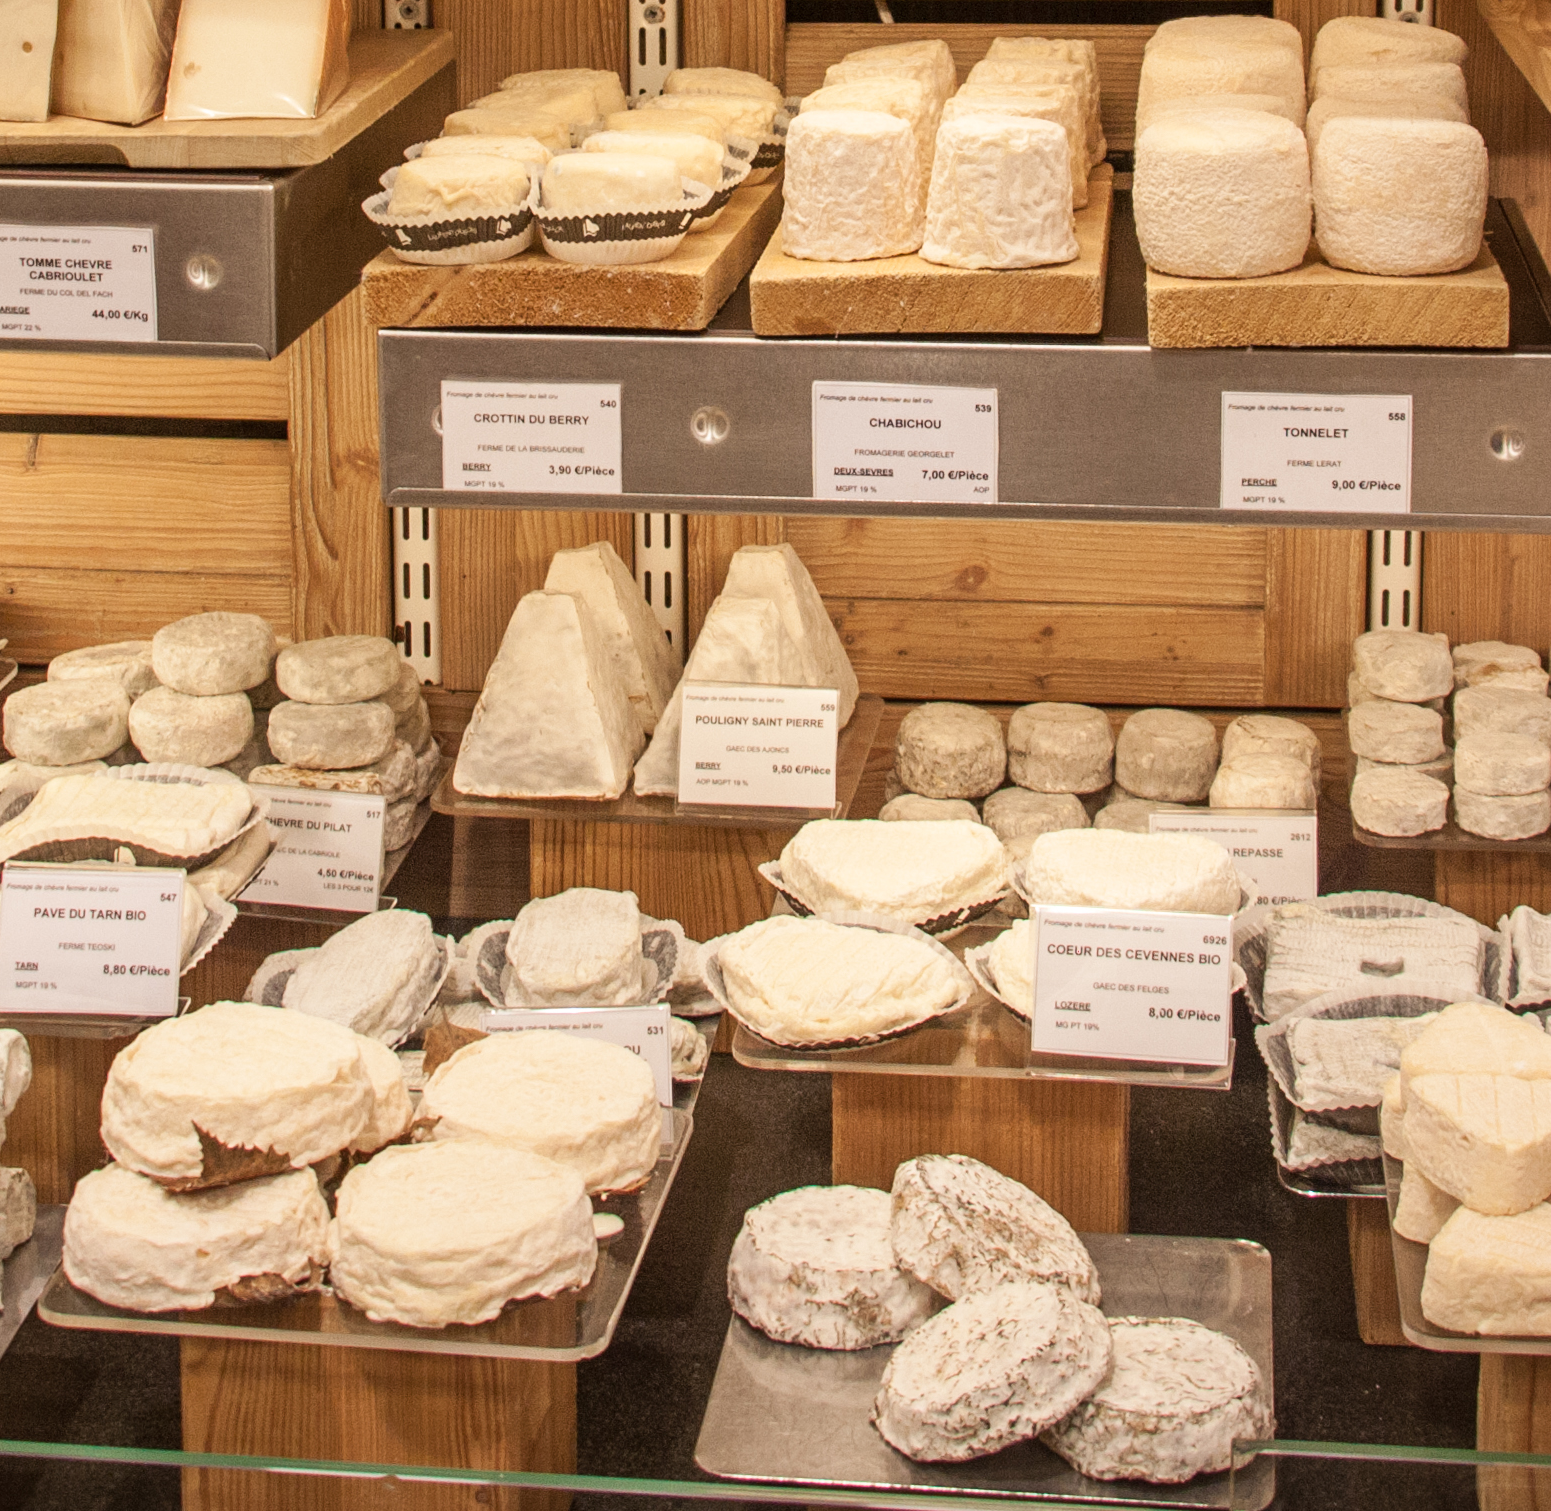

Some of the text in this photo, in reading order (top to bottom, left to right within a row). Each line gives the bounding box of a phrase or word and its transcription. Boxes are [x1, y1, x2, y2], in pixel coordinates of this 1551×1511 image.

[132, 245, 147, 253] 571
[20, 258, 112, 269] TOMME CHEVRE
[30, 271, 103, 282] CABRIOULET
[92, 310, 148, 322] 44,00 €/Kg
[600, 400, 616, 408] 540
[474, 414, 589, 425] CROTTIN DU BERRY
[870, 418, 941, 429] CHABICHOU
[1283, 428, 1348, 438] TONNELET
[855, 449, 904, 457] FROMAGERIE
[549, 465, 614, 476] 3,90 €/Pièce
[834, 468, 893, 476] DEUX-SEVRES
[922, 470, 989, 480] 7,00 €/Pièce
[1242, 478, 1277, 486] PERCHE
[1332, 480, 1401, 490] 9,00 €/Pièce
[696, 716, 823, 727] POULIGNY SAINT PIERRE
[773, 765, 831, 775] 9,50 €/Pièce
[307, 821, 320, 829] DU
[324, 823, 352, 832] PILAT
[1233, 849, 1283, 857] REPASSE
[161, 894, 176, 902] 547
[34, 908, 146, 920] PAVE DU TARN BIO
[1203, 936, 1227, 945] 6926
[1047, 945, 1221, 964] COEUR DES CEVENNES BIO
[104, 965, 170, 976] 8,80 €/Pièce
[1055, 1001, 1090, 1011] LOZERE
[1149, 1008, 1220, 1022] 8,00 €/Pièce
